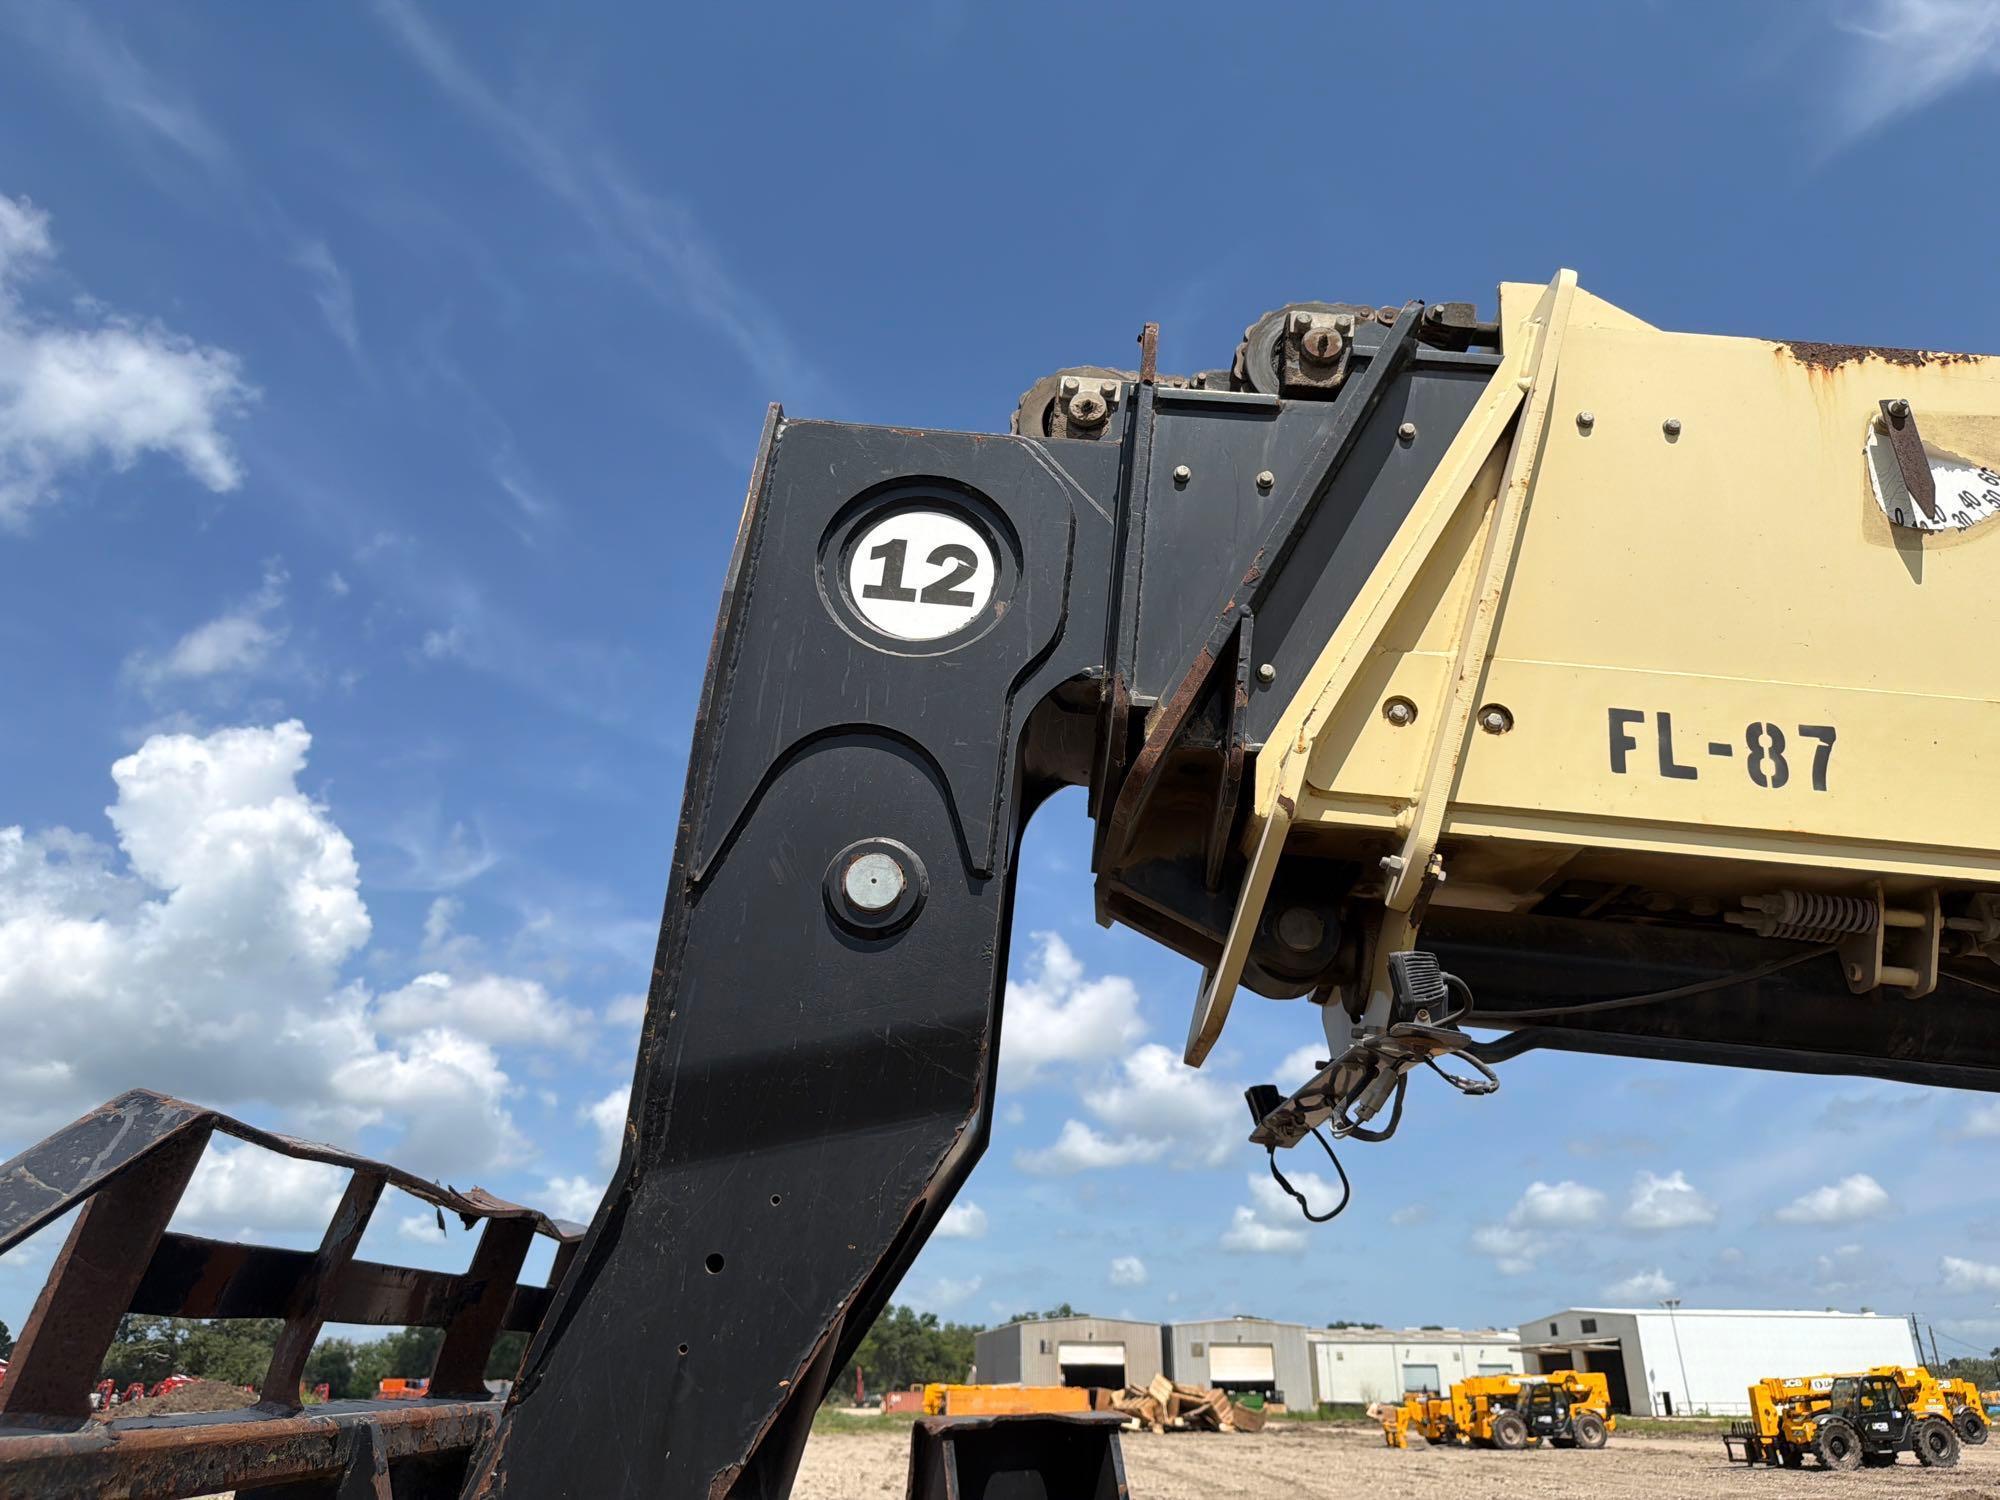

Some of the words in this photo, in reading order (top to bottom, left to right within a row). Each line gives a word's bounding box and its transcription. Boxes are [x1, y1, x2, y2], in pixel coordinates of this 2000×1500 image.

[1895, 507, 1904, 526] 0
[1958, 490, 1981, 510] 40
[862, 538, 979, 608] 12
[1608, 707, 1836, 792] FL-87
